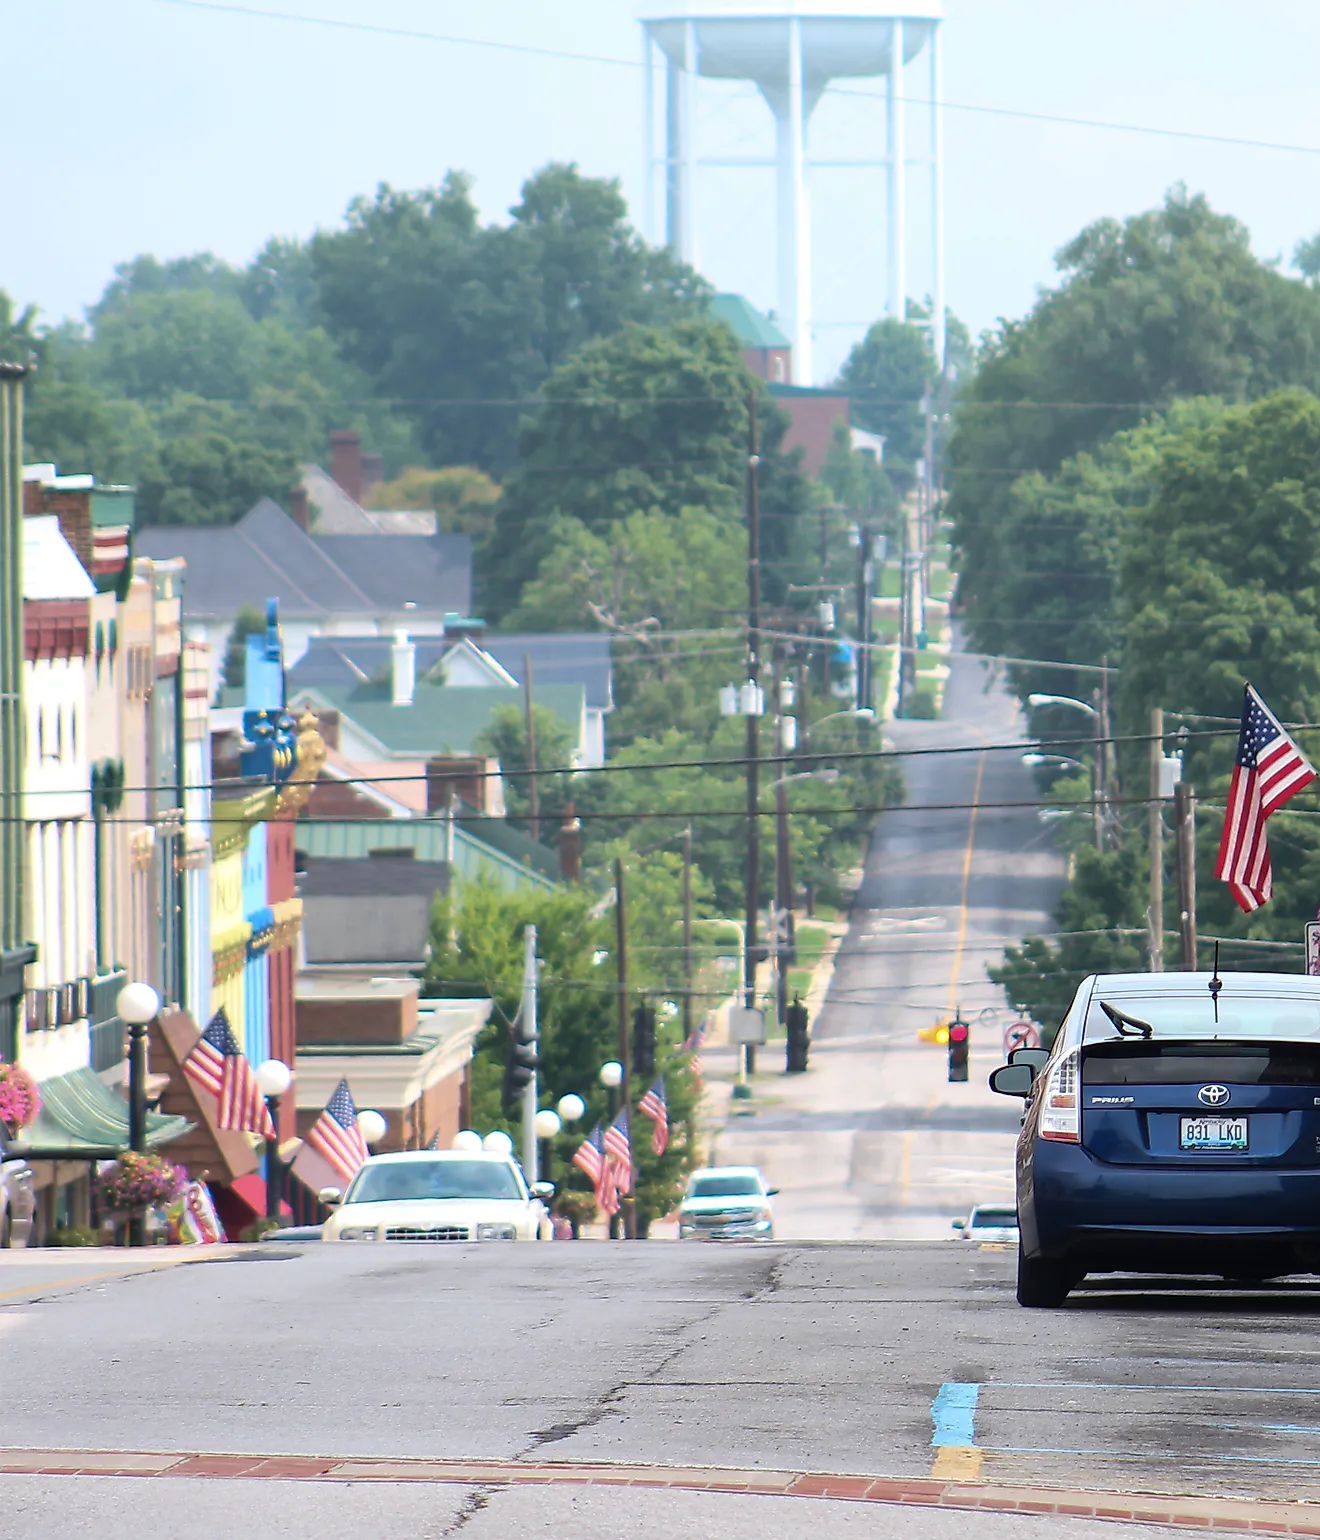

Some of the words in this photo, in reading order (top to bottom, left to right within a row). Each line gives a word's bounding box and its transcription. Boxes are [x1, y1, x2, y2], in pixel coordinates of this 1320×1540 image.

[1091, 1096, 1135, 1104] PRIUS
[1186, 1124, 1210, 1141] 831
[1219, 1124, 1243, 1141] LKD
